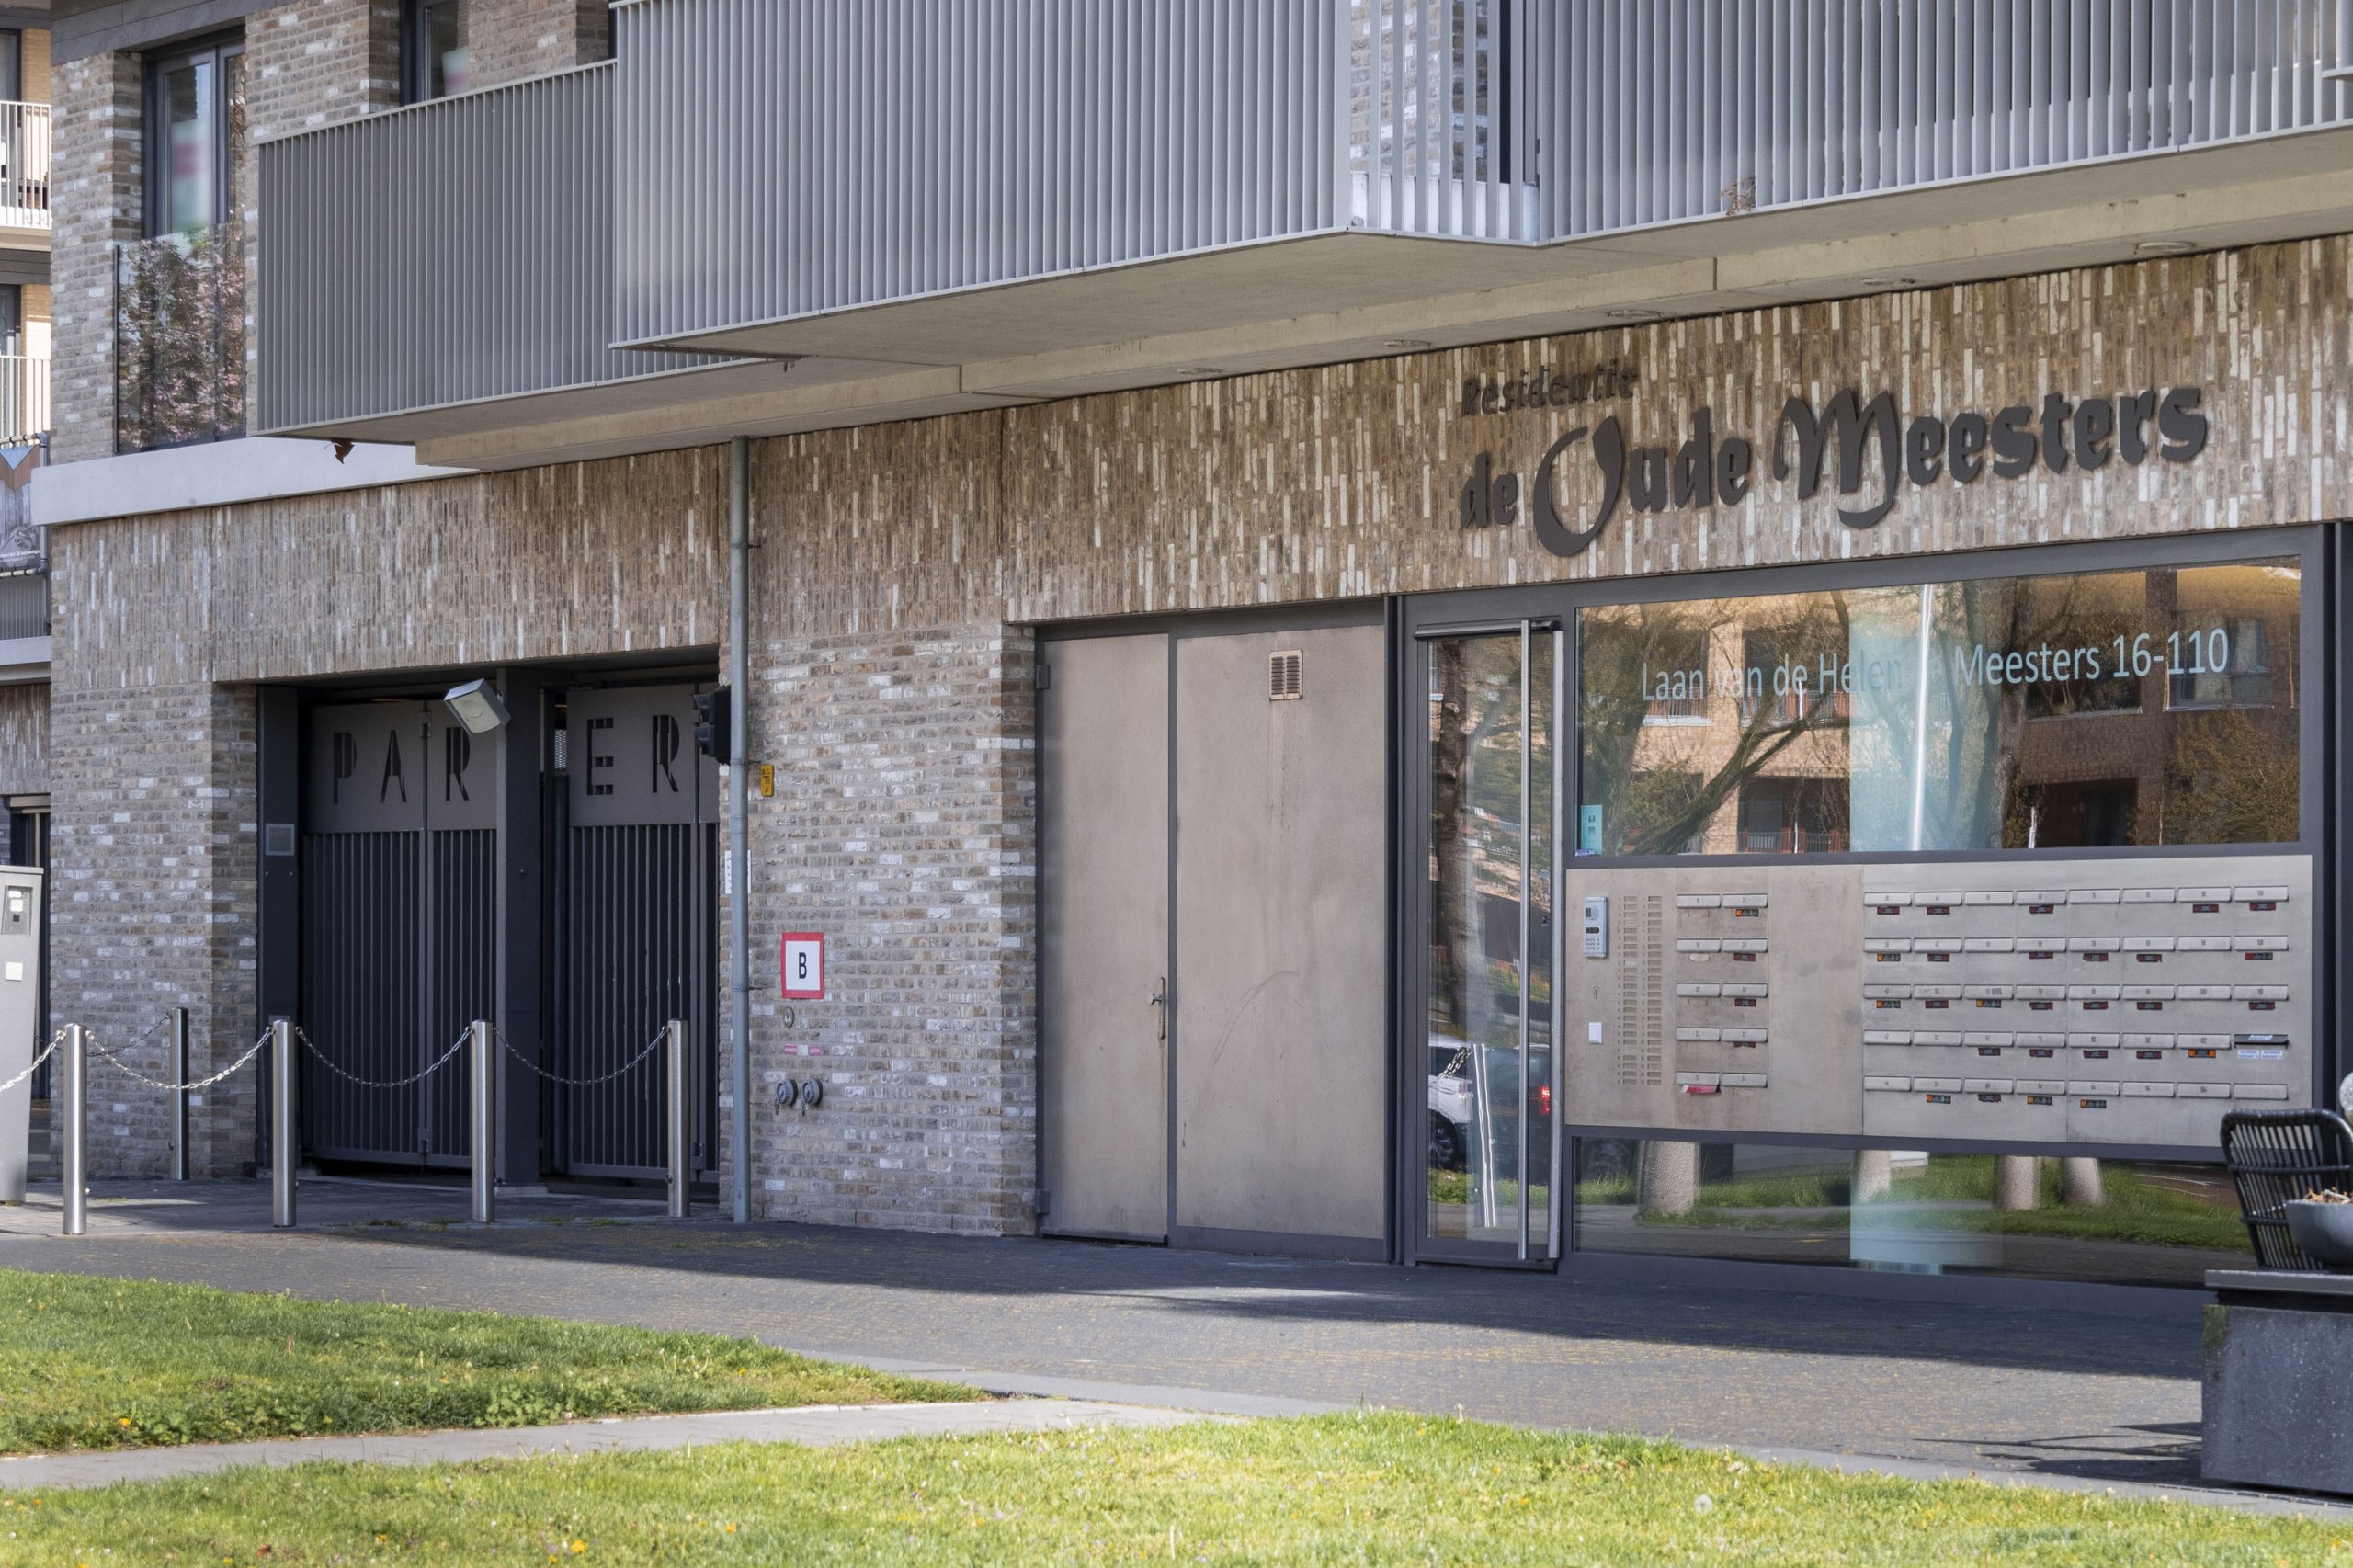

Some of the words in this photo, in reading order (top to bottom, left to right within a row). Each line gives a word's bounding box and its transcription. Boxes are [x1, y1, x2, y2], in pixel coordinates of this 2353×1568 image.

[1461, 359, 1637, 417] Residentie
[1461, 450, 1518, 528] de
[1533, 408, 1750, 557] Oude
[1773, 386, 2208, 528] Meesters
[1642, 661, 1705, 701] Laan
[1716, 665, 1763, 698] van
[1773, 653, 1808, 697] de
[1954, 642, 2101, 686] Meesters
[2113, 628, 2229, 678] 16-110
[798, 952, 808, 980] B
